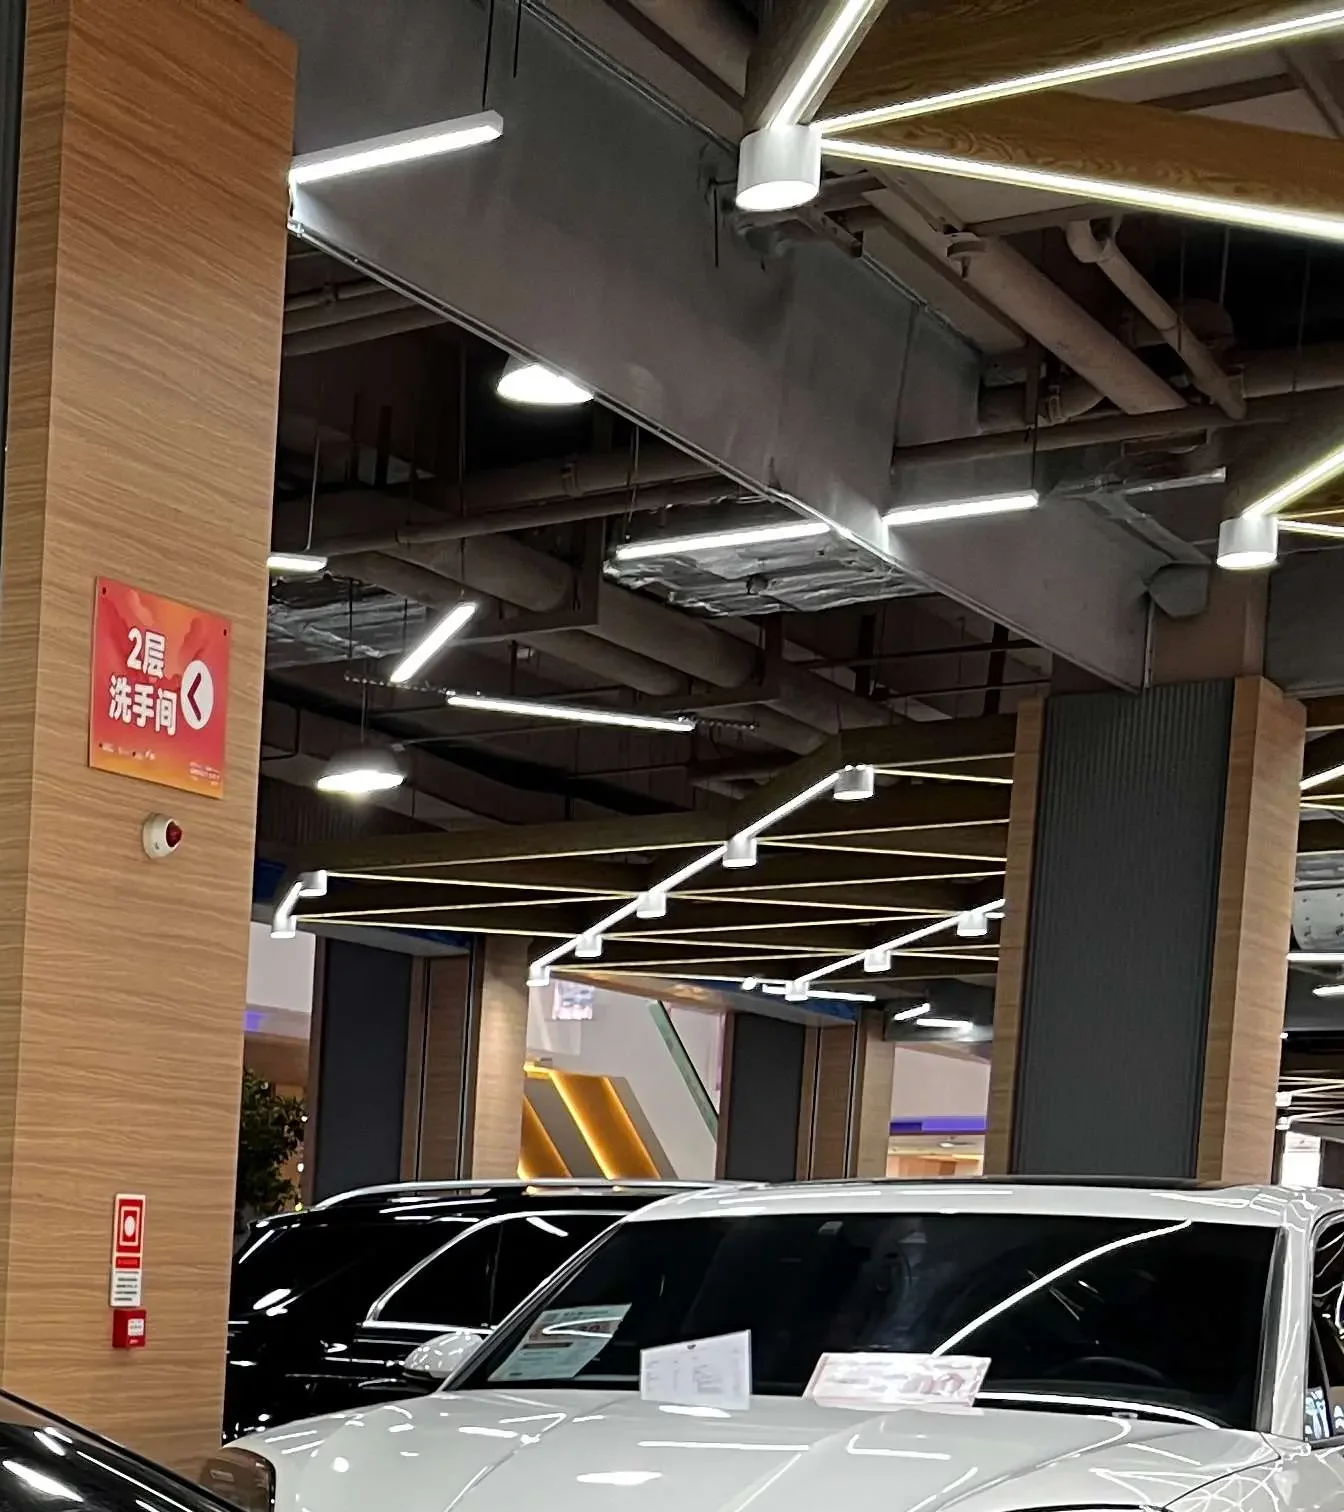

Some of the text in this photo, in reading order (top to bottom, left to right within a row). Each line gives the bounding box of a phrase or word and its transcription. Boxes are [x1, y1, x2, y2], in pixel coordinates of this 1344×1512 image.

[125, 627, 166, 679] 2层
[108, 675, 178, 736] 洗手间
